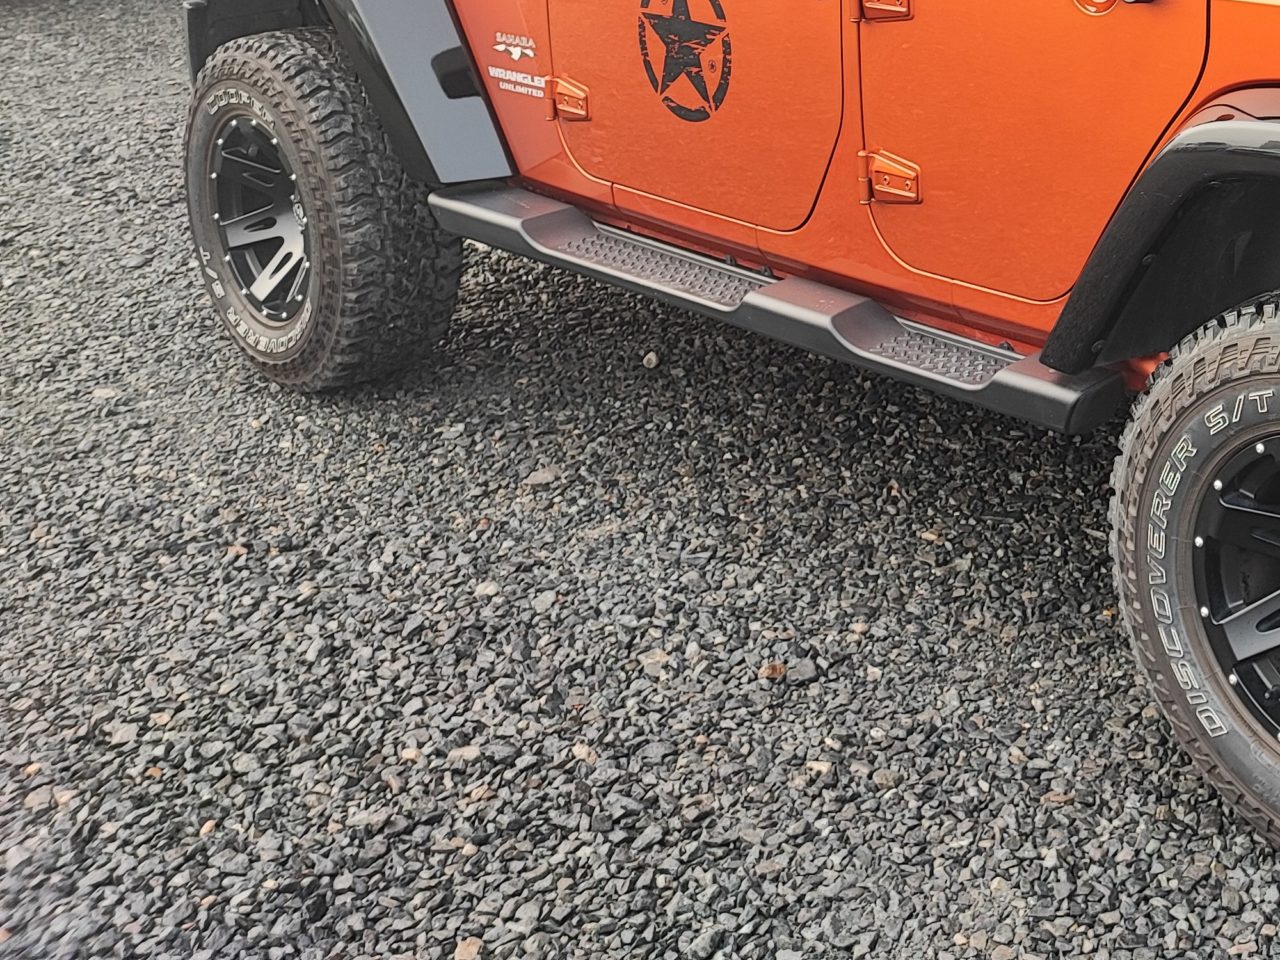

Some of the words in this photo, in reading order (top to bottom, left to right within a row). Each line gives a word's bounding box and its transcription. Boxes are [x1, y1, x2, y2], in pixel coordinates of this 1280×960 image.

[495, 31, 537, 49] SAHARA
[499, 81, 545, 98] UNLIMITED
[206, 88, 276, 130] COOPER
[1147, 434, 1229, 738] DISCOVERER
[1204, 389, 1276, 436] S/T
